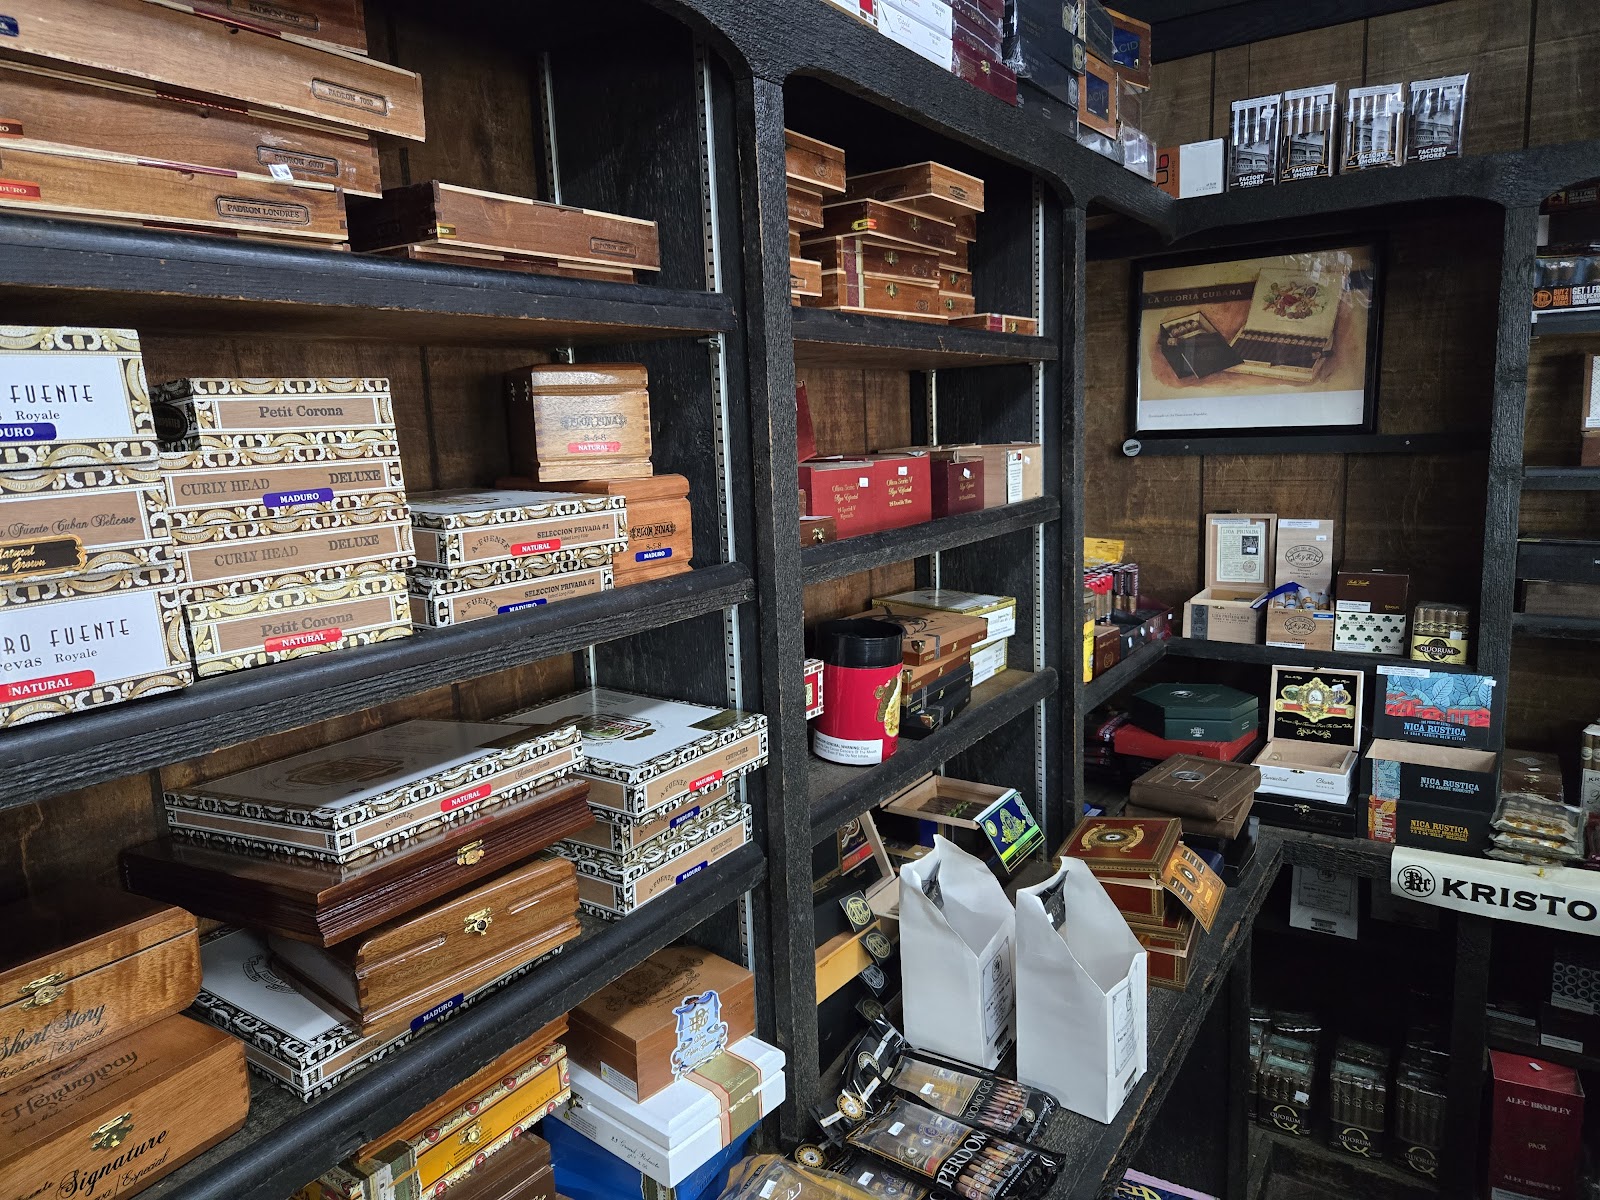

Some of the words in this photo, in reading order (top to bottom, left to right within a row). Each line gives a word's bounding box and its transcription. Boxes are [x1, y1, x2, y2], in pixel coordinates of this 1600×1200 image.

[1357, 151, 1389, 160] FACTORY
[1418, 146, 1448, 155] FACTORY
[1419, 152, 1447, 160] SMOKES
[1358, 157, 1384, 165] SMOKES
[1291, 165, 1319, 174] FACTORY
[1292, 171, 1318, 179] SMOKES
[1239, 173, 1265, 183] FACTORY
[1240, 179, 1264, 187] SMOKES
[227, 204, 260, 215] PADRON
[262, 207, 300, 219] LONDRES
[1148, 296, 1160, 304] LA
[1163, 293, 1200, 303] GLORIA
[1202, 288, 1243, 299] CUBANA
[1572, 286, 1585, 295] GET
[1586, 286, 1591, 295] 1
[9, 384, 94, 403] FUENTE
[15, 410, 61, 423] Royale
[258, 405, 293, 419] Petit
[296, 404, 344, 417] Corona
[6, 481, 28, 490] HAND
[29, 479, 48, 489] MADE
[180, 481, 227, 496] CURLY
[231, 478, 270, 492] HEAD
[328, 469, 382, 485] DELUXE
[279, 492, 320, 503] MADURO
[8, 522, 49, 538] Fuente
[52, 517, 89, 534] Cuban
[91, 513, 137, 528] Belicoso
[536, 528, 574, 539] SELECCION
[574, 524, 602, 535] PRIVADA
[214, 550, 258, 567] CURLY
[261, 545, 299, 562] HEAD
[327, 534, 380, 552] DELUXE
[521, 542, 551, 552] NATURAL
[643, 550, 666, 560] MADURO
[12, 558, 47, 574] Grown
[524, 585, 556, 599] SELECCION
[557, 580, 586, 592] PRIVADA
[509, 602, 538, 613] MADURO
[260, 621, 299, 638] Petit
[301, 612, 354, 631] Corona
[49, 618, 130, 648] FUENTE
[281, 632, 327, 647] NATURAL
[55, 648, 98, 664] Royale
[1420, 646, 1454, 655] QUORUM
[12, 677, 73, 697] NATURAL
[1403, 721, 1426, 732] NICA
[1427, 724, 1467, 737] RUSTICA
[695, 774, 716, 788] NATURAL
[1420, 776, 1441, 786] NICA
[1443, 779, 1480, 792] RUSTICA
[451, 790, 481, 806] NATURAL
[676, 811, 695, 824] MADURO
[1410, 819, 1430, 829] NICA
[1432, 822, 1469, 835] RUSTICA
[682, 865, 702, 881] MADURO
[1441, 877, 1598, 922] KRISTO
[422, 1000, 454, 1023] MADURO
[0, 1028, 49, 1062] Short
[53, 1004, 106, 1034] Story
[2, 1050, 138, 1120] Hemingway
[512, 1102, 533, 1122] CEDROS
[1505, 1096, 1529, 1107] ALEC
[1530, 1101, 1572, 1117] BRADLEY
[1270, 1111, 1301, 1125] QUORUM
[1338, 1133, 1372, 1148] QUORUM
[1527, 1141, 1548, 1151] PACK
[55, 1129, 168, 1200] Signature
[121, 1147, 171, 1187] Especial
[1404, 1152, 1439, 1167] QUORUM
